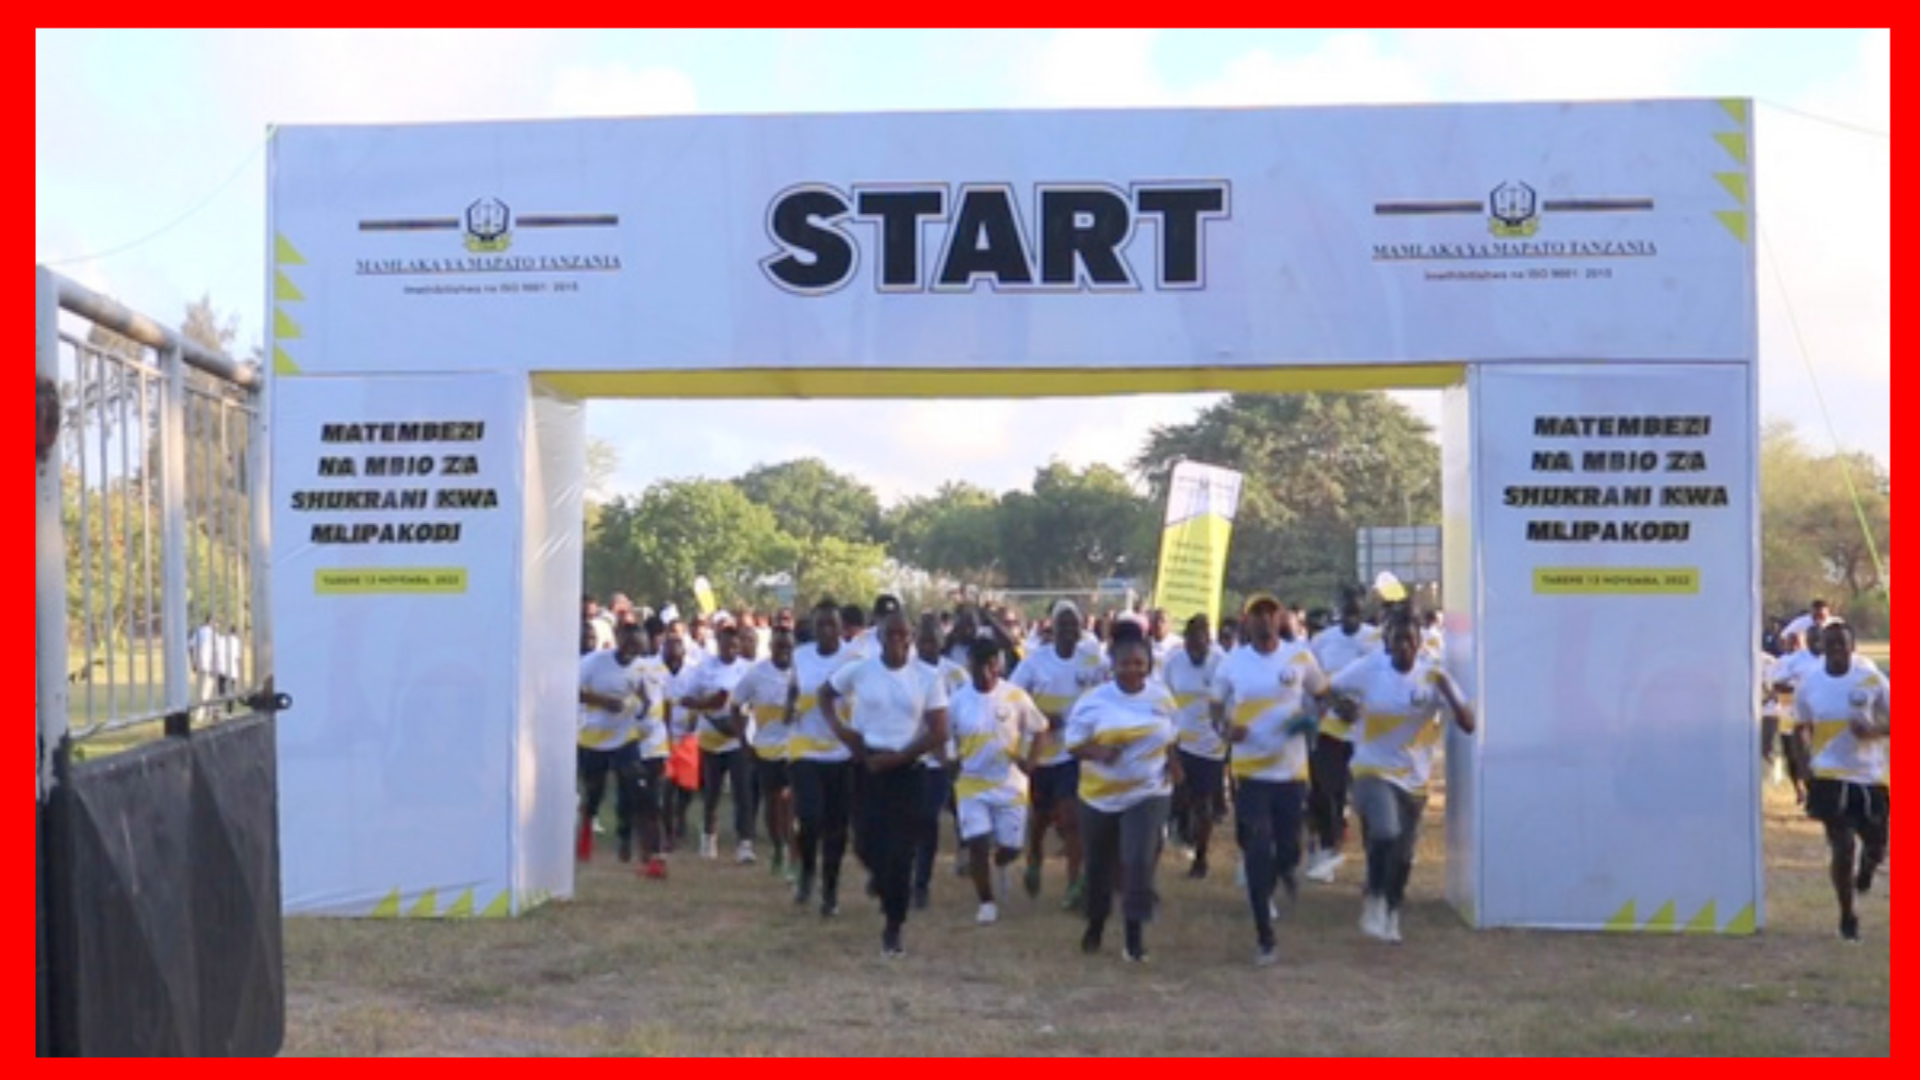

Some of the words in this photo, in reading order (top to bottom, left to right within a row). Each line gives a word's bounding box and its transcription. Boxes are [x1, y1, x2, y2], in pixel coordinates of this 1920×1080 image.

[761, 180, 1230, 295] START
[1570, 241, 1657, 256] TANZANIA
[540, 255, 621, 270] TANZANIA
[321, 421, 485, 442] MATEMBEZI
[1534, 416, 1711, 436] MATEMBEZI
[318, 456, 356, 476] NA
[364, 456, 434, 476] MBIO
[441, 456, 478, 476] ZA
[1531, 451, 1573, 472] NA
[1582, 451, 1657, 472] MBIO
[1664, 451, 1706, 472] ZA
[291, 490, 428, 510] SHUKRANI
[434, 489, 498, 509] KWA
[1503, 485, 1652, 507] SHUKRANI
[1659, 485, 1728, 506] KWA
[310, 523, 461, 543] MLIPAKODI
[1526, 521, 1690, 541] MLIPAKODI
